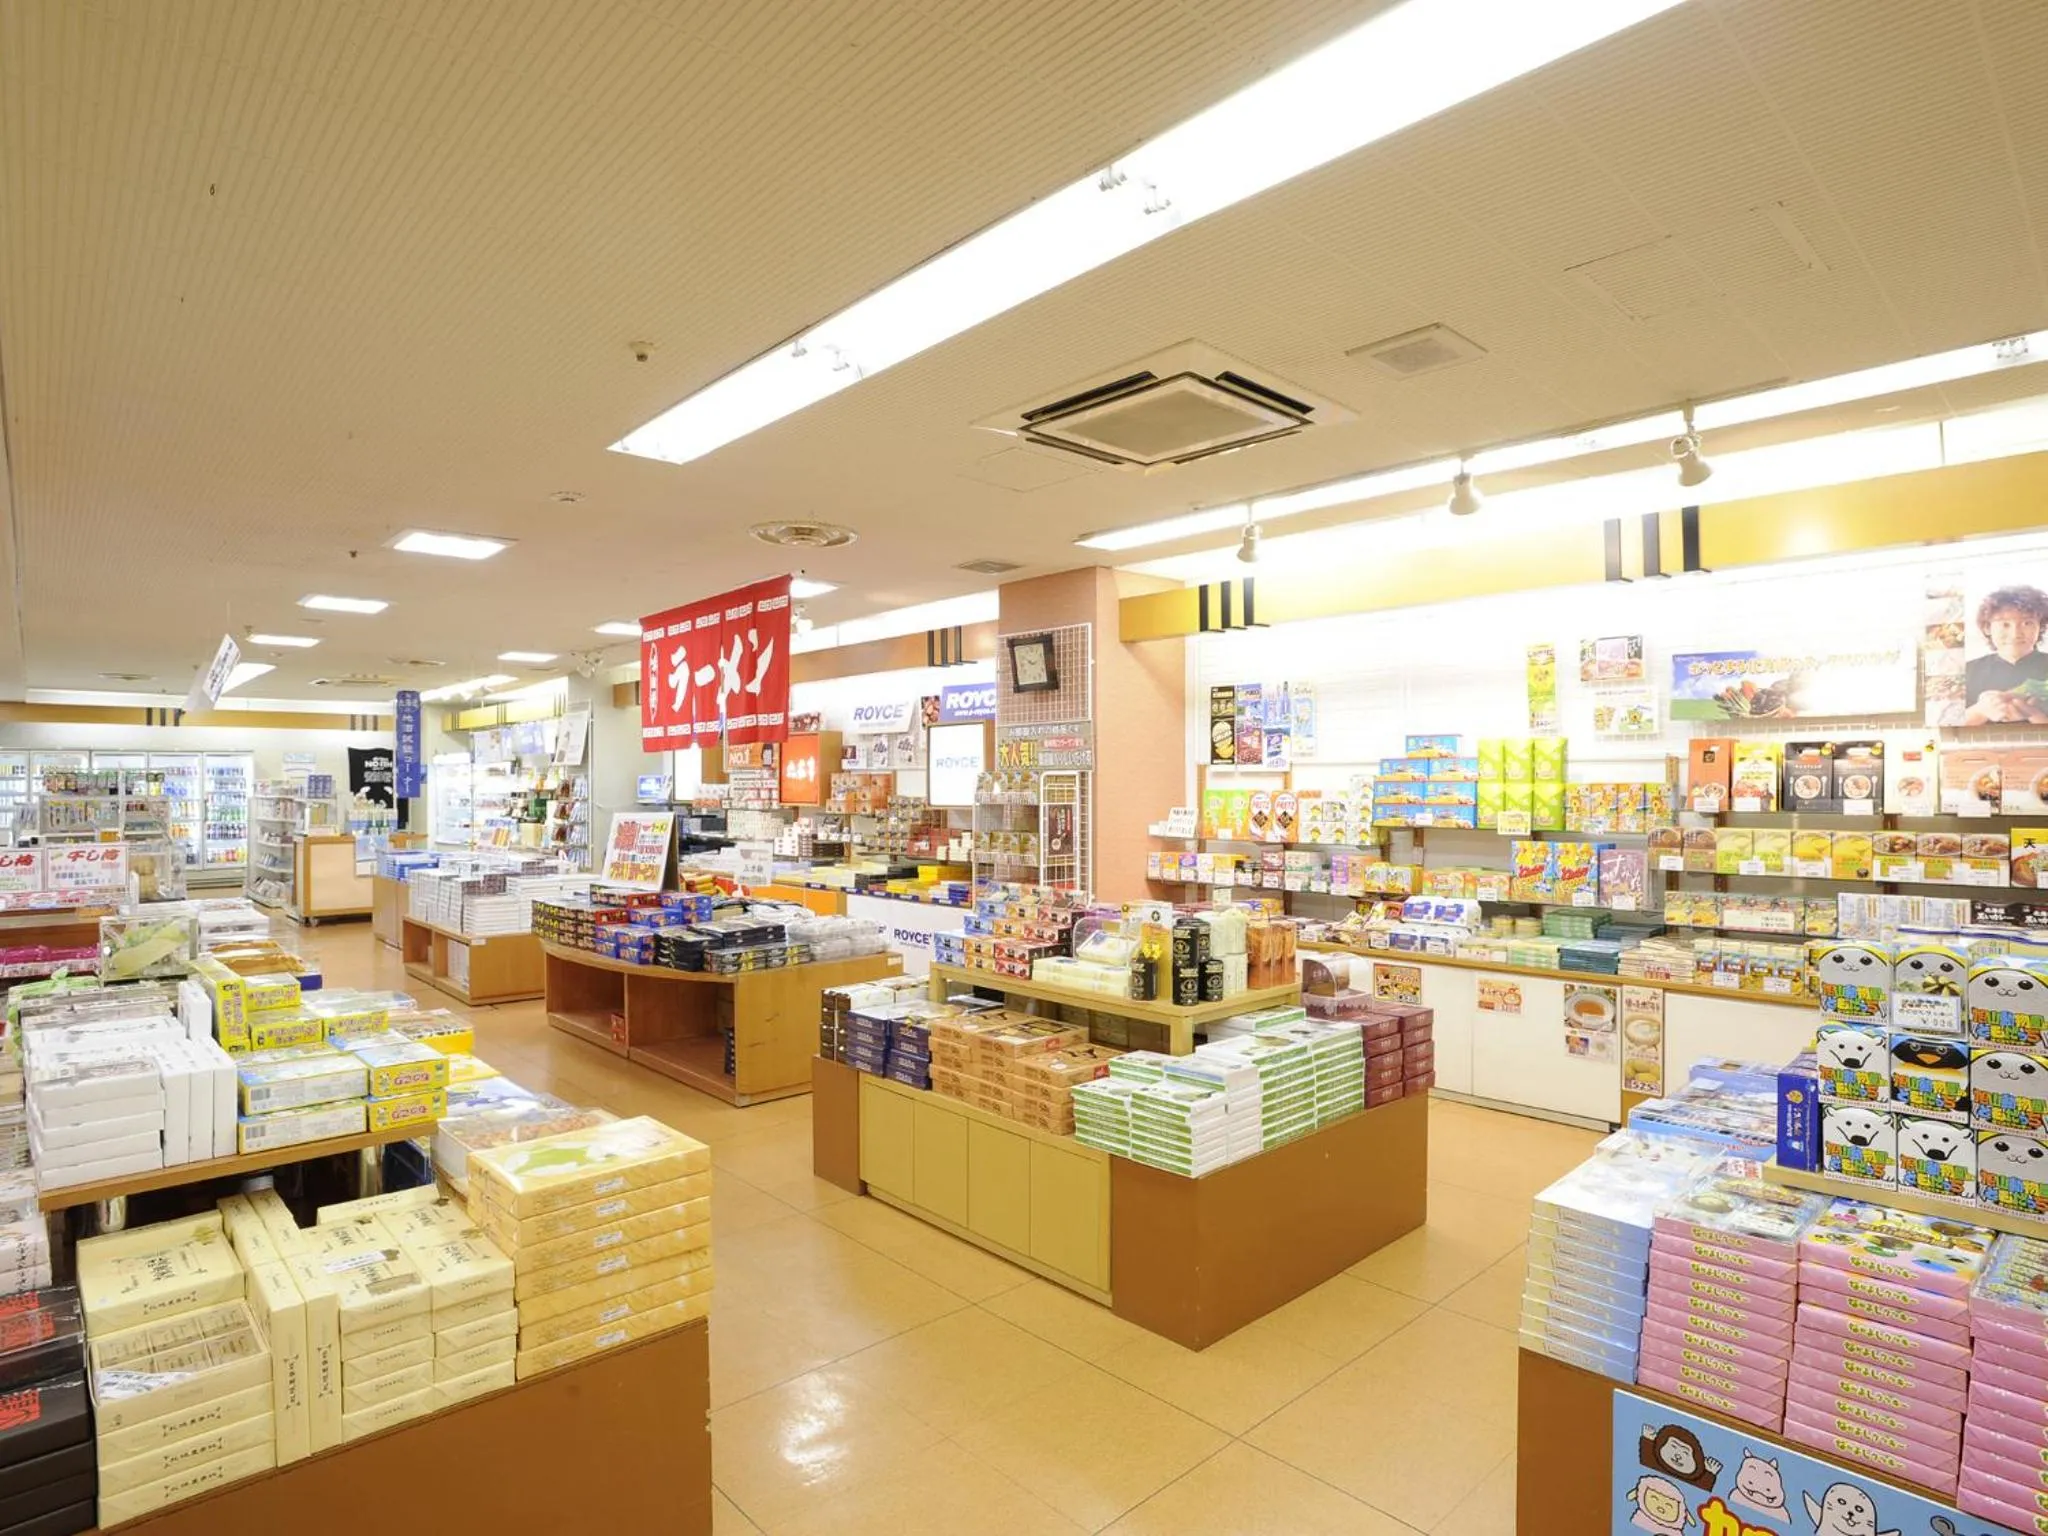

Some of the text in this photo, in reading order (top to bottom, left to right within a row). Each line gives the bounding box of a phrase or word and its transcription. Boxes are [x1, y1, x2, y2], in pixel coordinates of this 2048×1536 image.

[668, 628, 774, 712] ラーメン
[1693, 1243, 1752, 1266] なかよしクッキー
[1849, 1255, 1919, 1279] なかよしクッキー
[1690, 1261, 1750, 1284] なかよしクッキー
[1690, 1281, 1750, 1303] なかよしクッキー
[1848, 1279, 1919, 1305] なかよしクッキー
[1688, 1296, 1748, 1320] なかよしクッキー
[1848, 1297, 1917, 1324] なかよしクッキー
[1688, 1314, 1748, 1339] なかよしクッキー
[1848, 1322, 1919, 1348] なかよしクッキー
[1683, 1331, 1744, 1357] なかよしクッキー
[1843, 1341, 1915, 1368] なかよしクッキー
[1681, 1348, 1741, 1375] なかよしクッキー
[1843, 1360, 1915, 1388] なかよしクッキー
[1680, 1363, 1740, 1391] なかよしクッキー
[1678, 1382, 1737, 1410] なかよしクッキー
[1839, 1380, 1911, 1409] なかよしクッキー
[1836, 1400, 1908, 1429] なかよしクッキー
[1836, 1418, 1908, 1449] なかよしクッキー
[1834, 1438, 1906, 1469] なかよしクッキー
